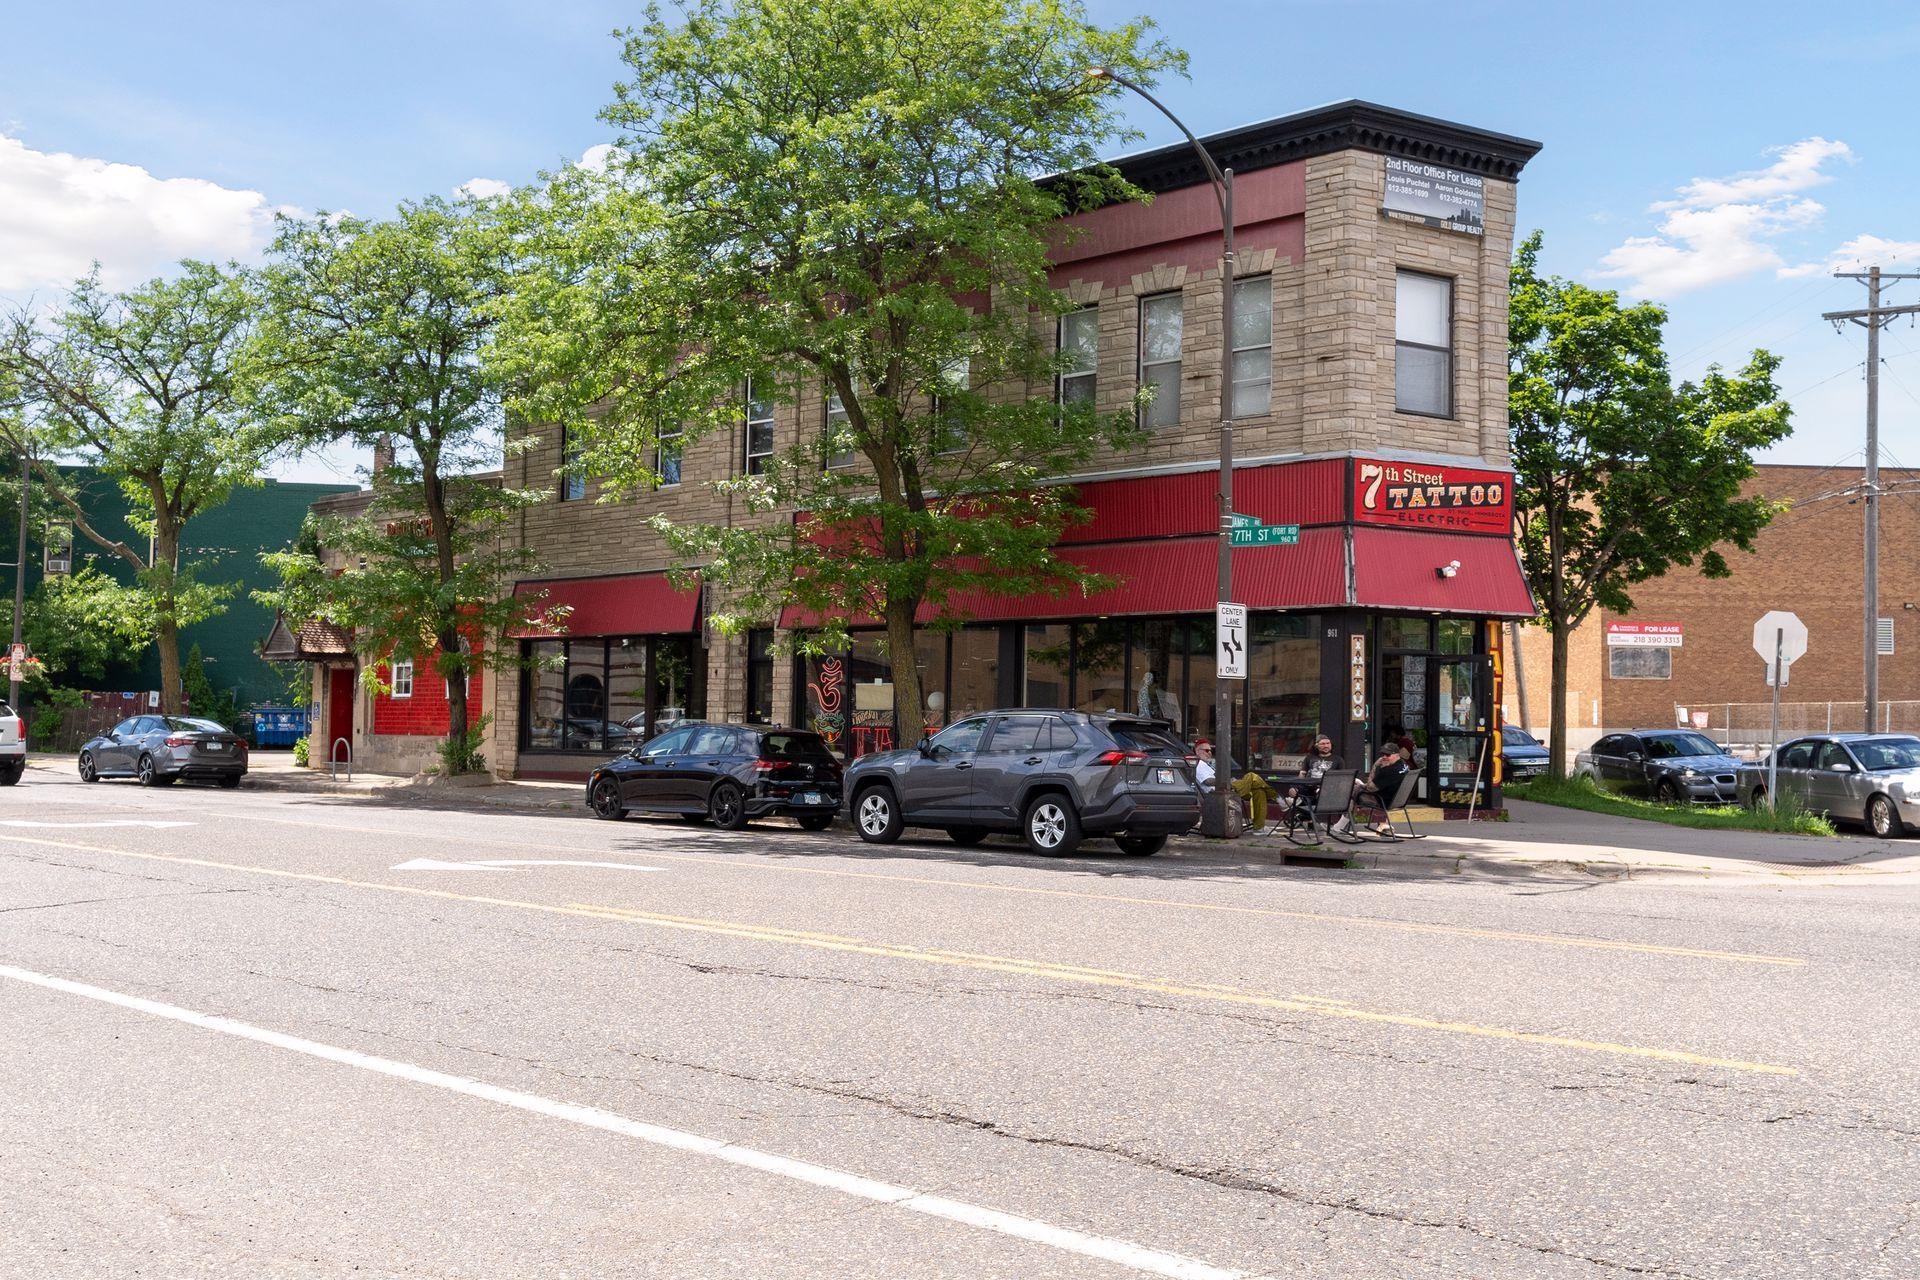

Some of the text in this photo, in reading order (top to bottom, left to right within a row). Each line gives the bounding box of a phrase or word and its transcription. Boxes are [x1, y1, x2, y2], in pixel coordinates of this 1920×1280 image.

[1386, 157, 1483, 188] 2nd Floor Office For Lease
[1387, 174, 1405, 184] Louis
[1435, 183, 1453, 193] Aaron
[1452, 222, 1466, 232] GROUP
[1467, 225, 1483, 236] REALTY
[1361, 464, 1444, 509] 7th Street
[1389, 485, 1502, 508] TATTOO
[1398, 512, 1470, 526] ELECTRIC
[1235, 529, 1269, 541] 7TH ST
[1225, 666, 1239, 674] ONLY
[1352, 636, 1364, 718] TATTOO
